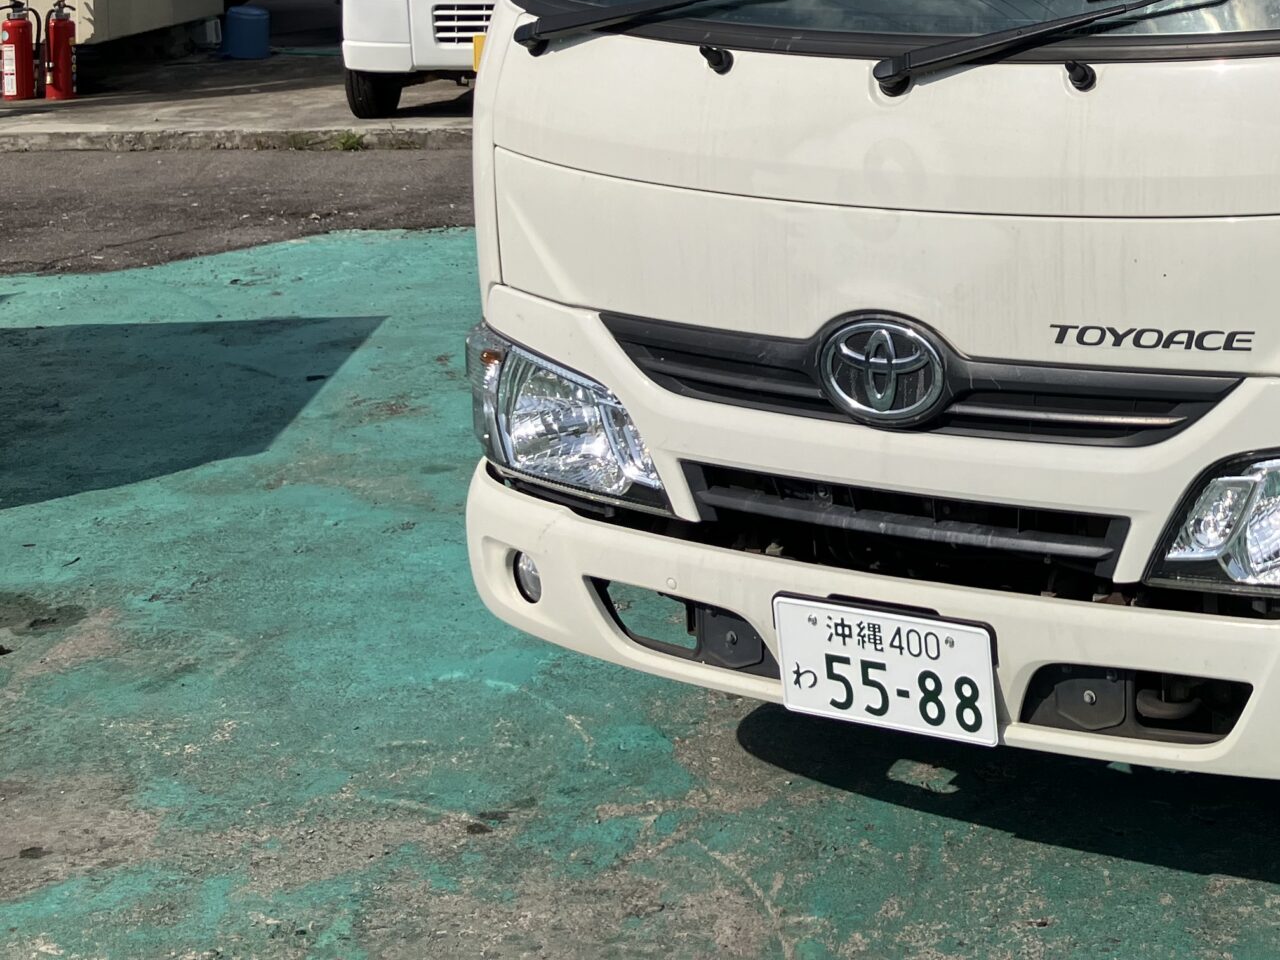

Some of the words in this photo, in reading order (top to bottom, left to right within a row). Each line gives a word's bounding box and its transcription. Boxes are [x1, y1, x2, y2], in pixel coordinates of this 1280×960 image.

[1049, 323, 1256, 352] TOYOACE
[792, 661, 818, 690] わ
[824, 652, 983, 734] 55-88
